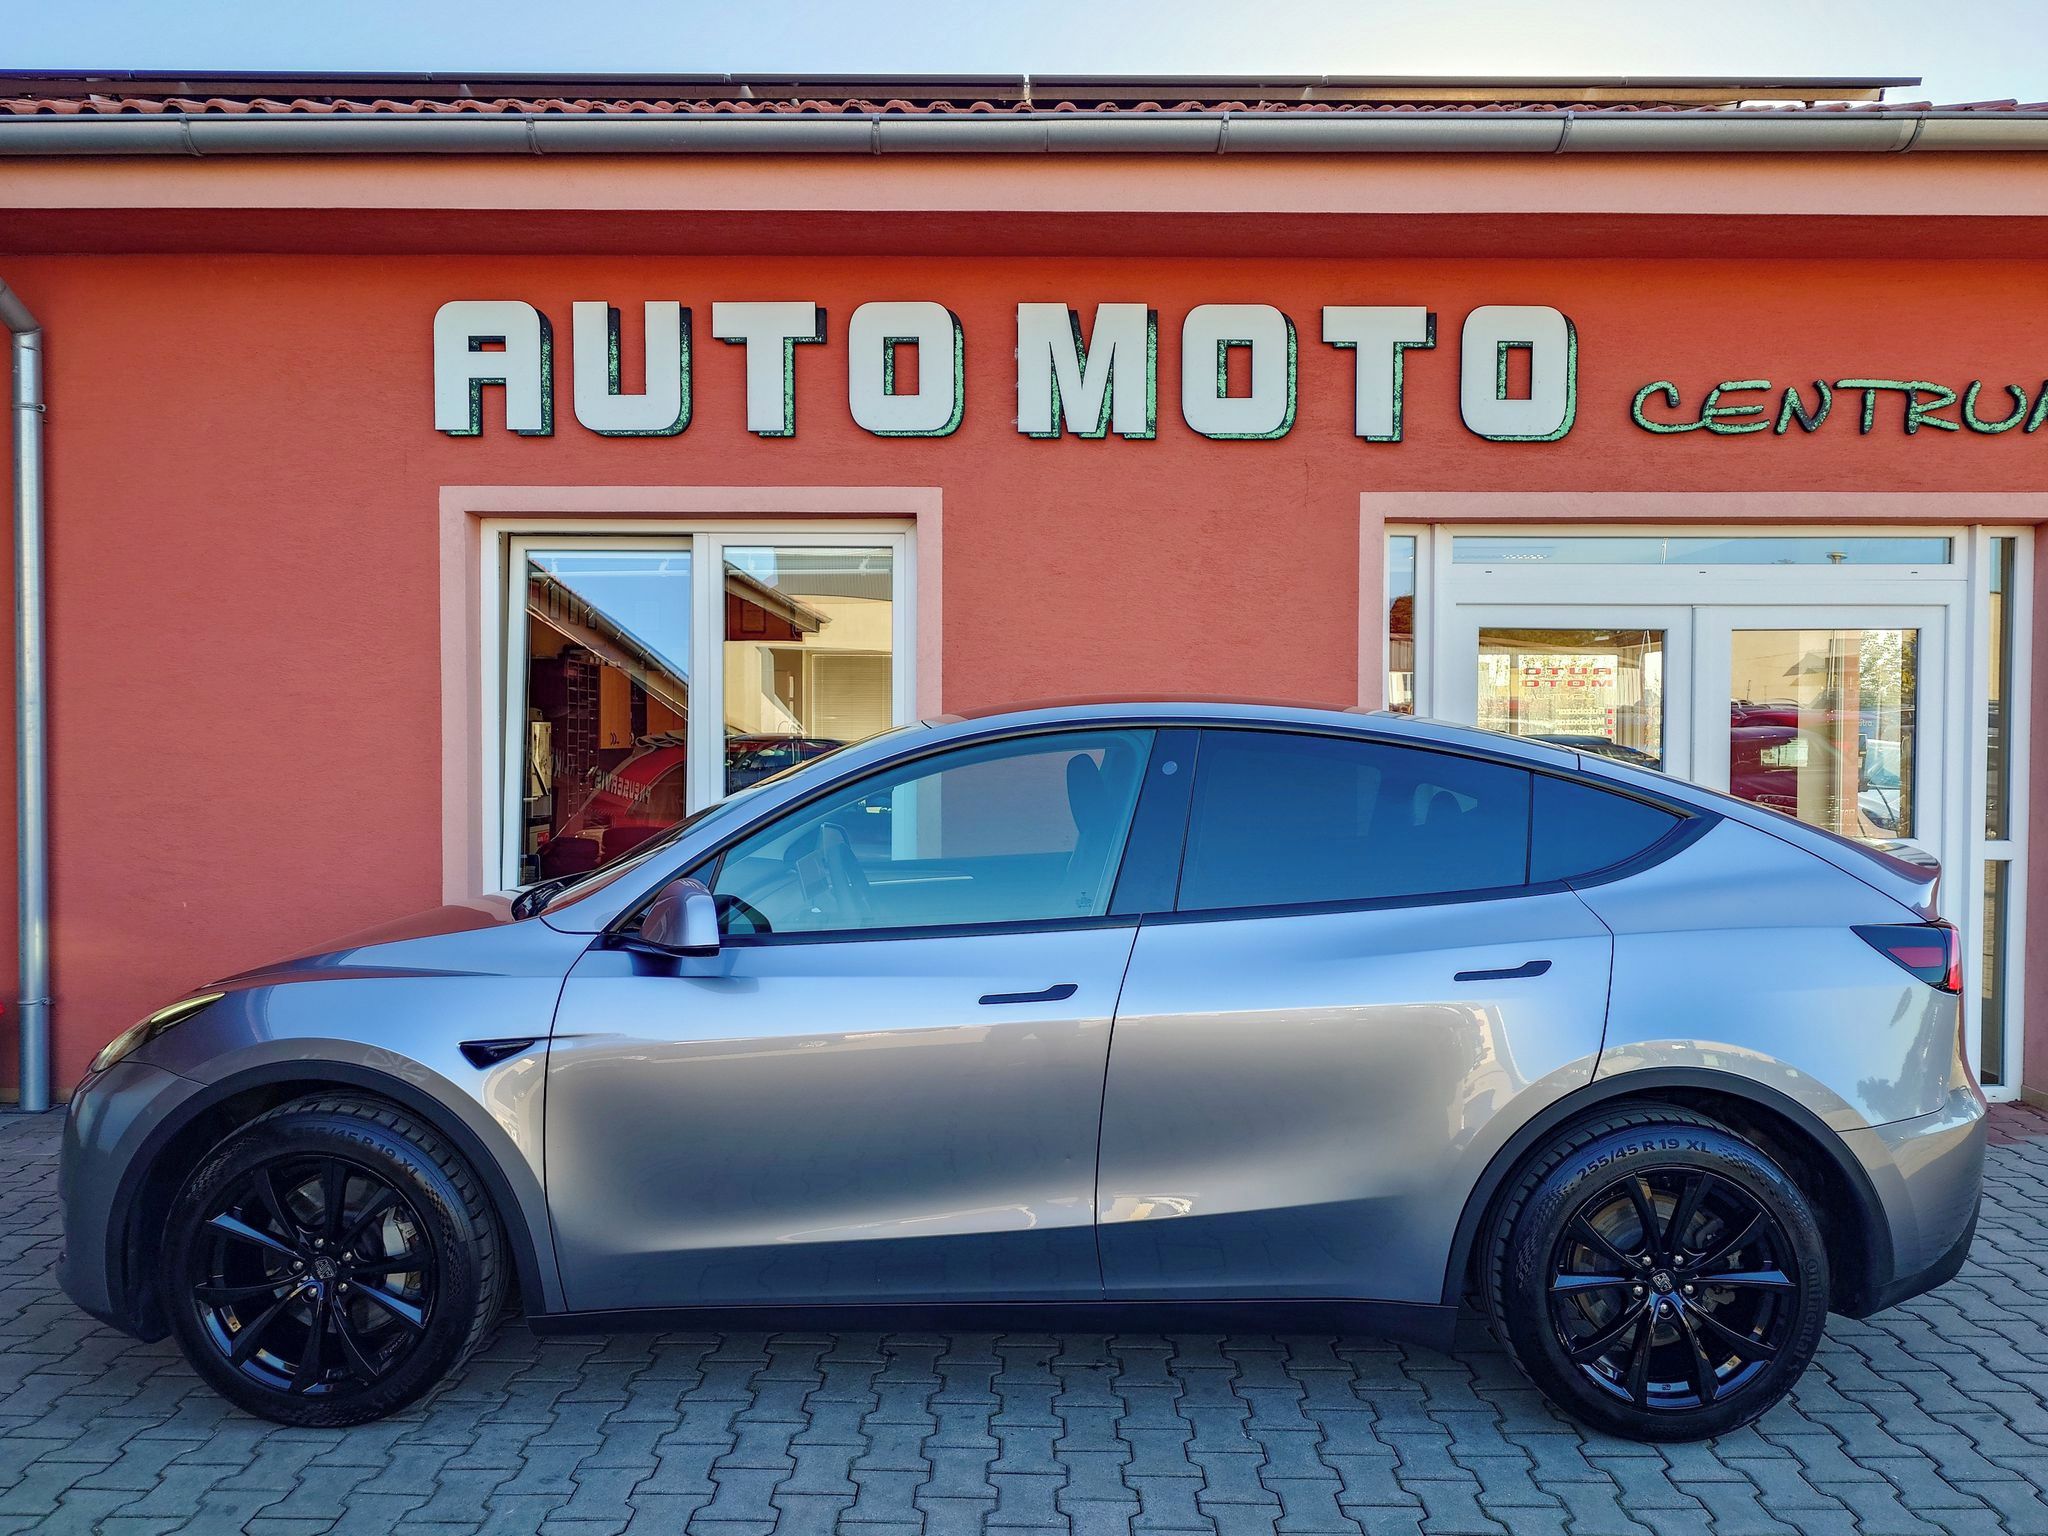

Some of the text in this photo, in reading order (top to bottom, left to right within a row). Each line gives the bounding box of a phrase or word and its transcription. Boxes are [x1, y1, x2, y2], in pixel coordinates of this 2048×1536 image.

[433, 300, 966, 437] AUTO
[1015, 301, 1578, 443] MOTO
[1576, 1142, 1639, 1181] 255/45
[1685, 1138, 1711, 1154] XL
